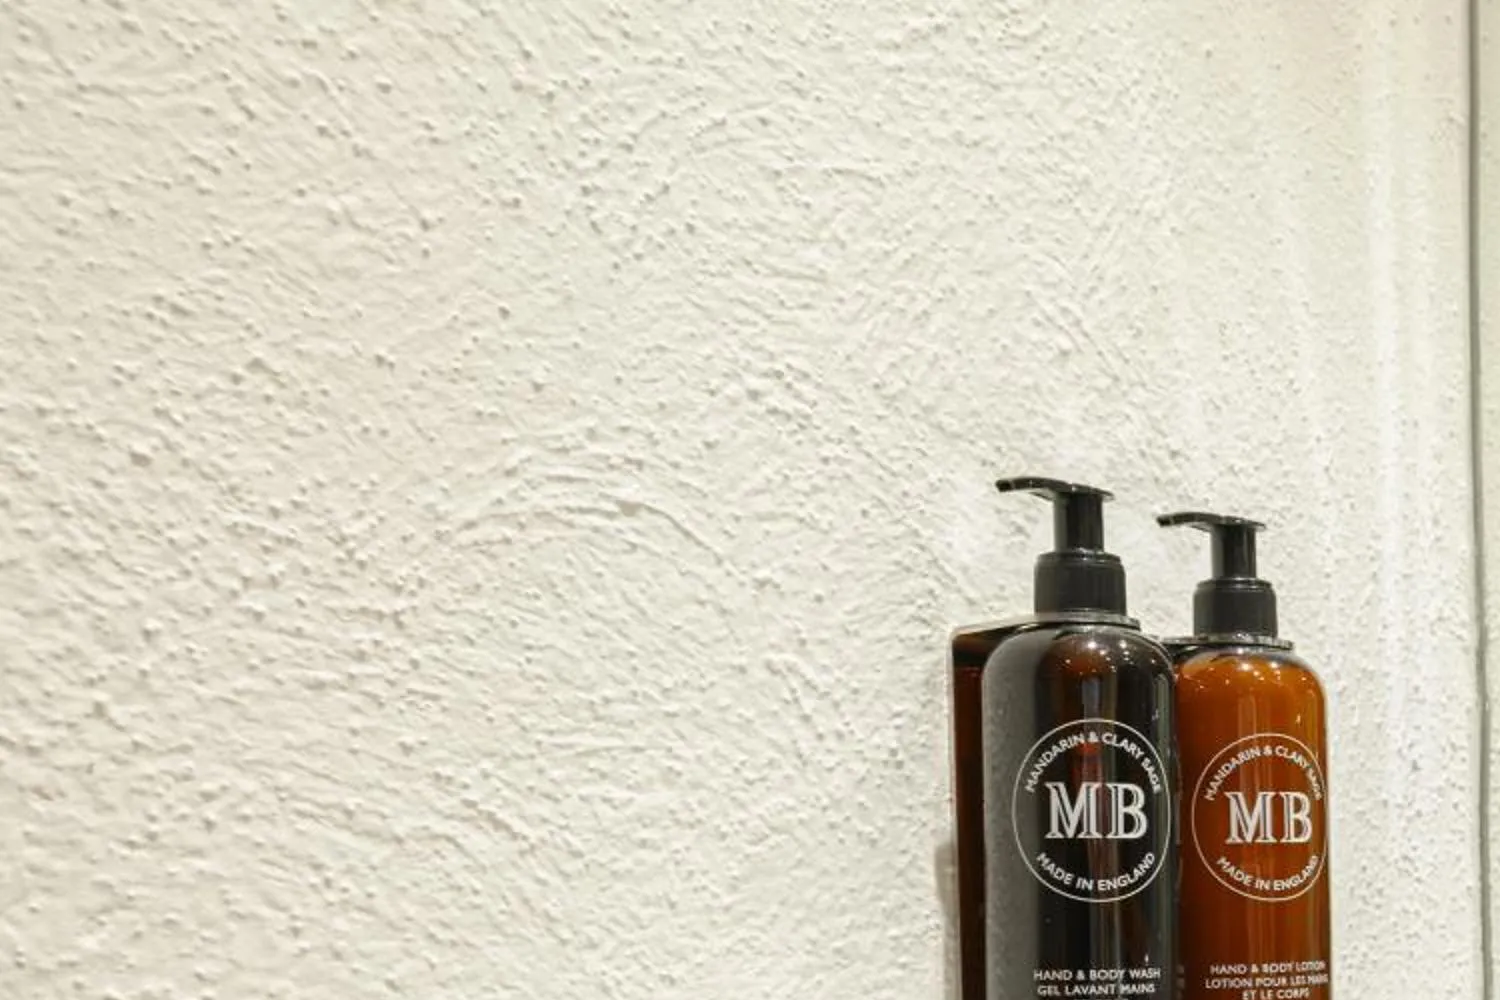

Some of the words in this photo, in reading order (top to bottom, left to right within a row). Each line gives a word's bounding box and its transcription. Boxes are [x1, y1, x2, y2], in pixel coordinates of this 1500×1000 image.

[1024, 733, 1085, 793] MANDARIN
[1088, 732, 1099, 743] &
[1102, 732, 1144, 759] CLARY
[1141, 758, 1162, 794] SAGE
[1204, 746, 1261, 801] MANDARIN
[1045, 782, 1148, 839] MB
[1225, 792, 1312, 844] MB
[1036, 852, 1074, 885] MADE
[1075, 877, 1094, 891] IN
[1097, 852, 1155, 891] ENGLAND
[1216, 856, 1253, 886] MADE
[1255, 879, 1270, 891] IN
[1273, 855, 1319, 891] ENGLAND
[1033, 969, 1073, 981] HAND
[1076, 968, 1086, 980] &
[1089, 968, 1125, 980] BODY
[1129, 967, 1161, 979] WASH
[1205, 976, 1252, 989] LOTION
[1210, 963, 1248, 975] HAND
[1037, 985, 1061, 996] GEL
[1065, 983, 1117, 996] LAVANT
[1120, 983, 1156, 994] MAINS
[1242, 989, 1257, 1000] ET
[1260, 989, 1273, 1000] LE
